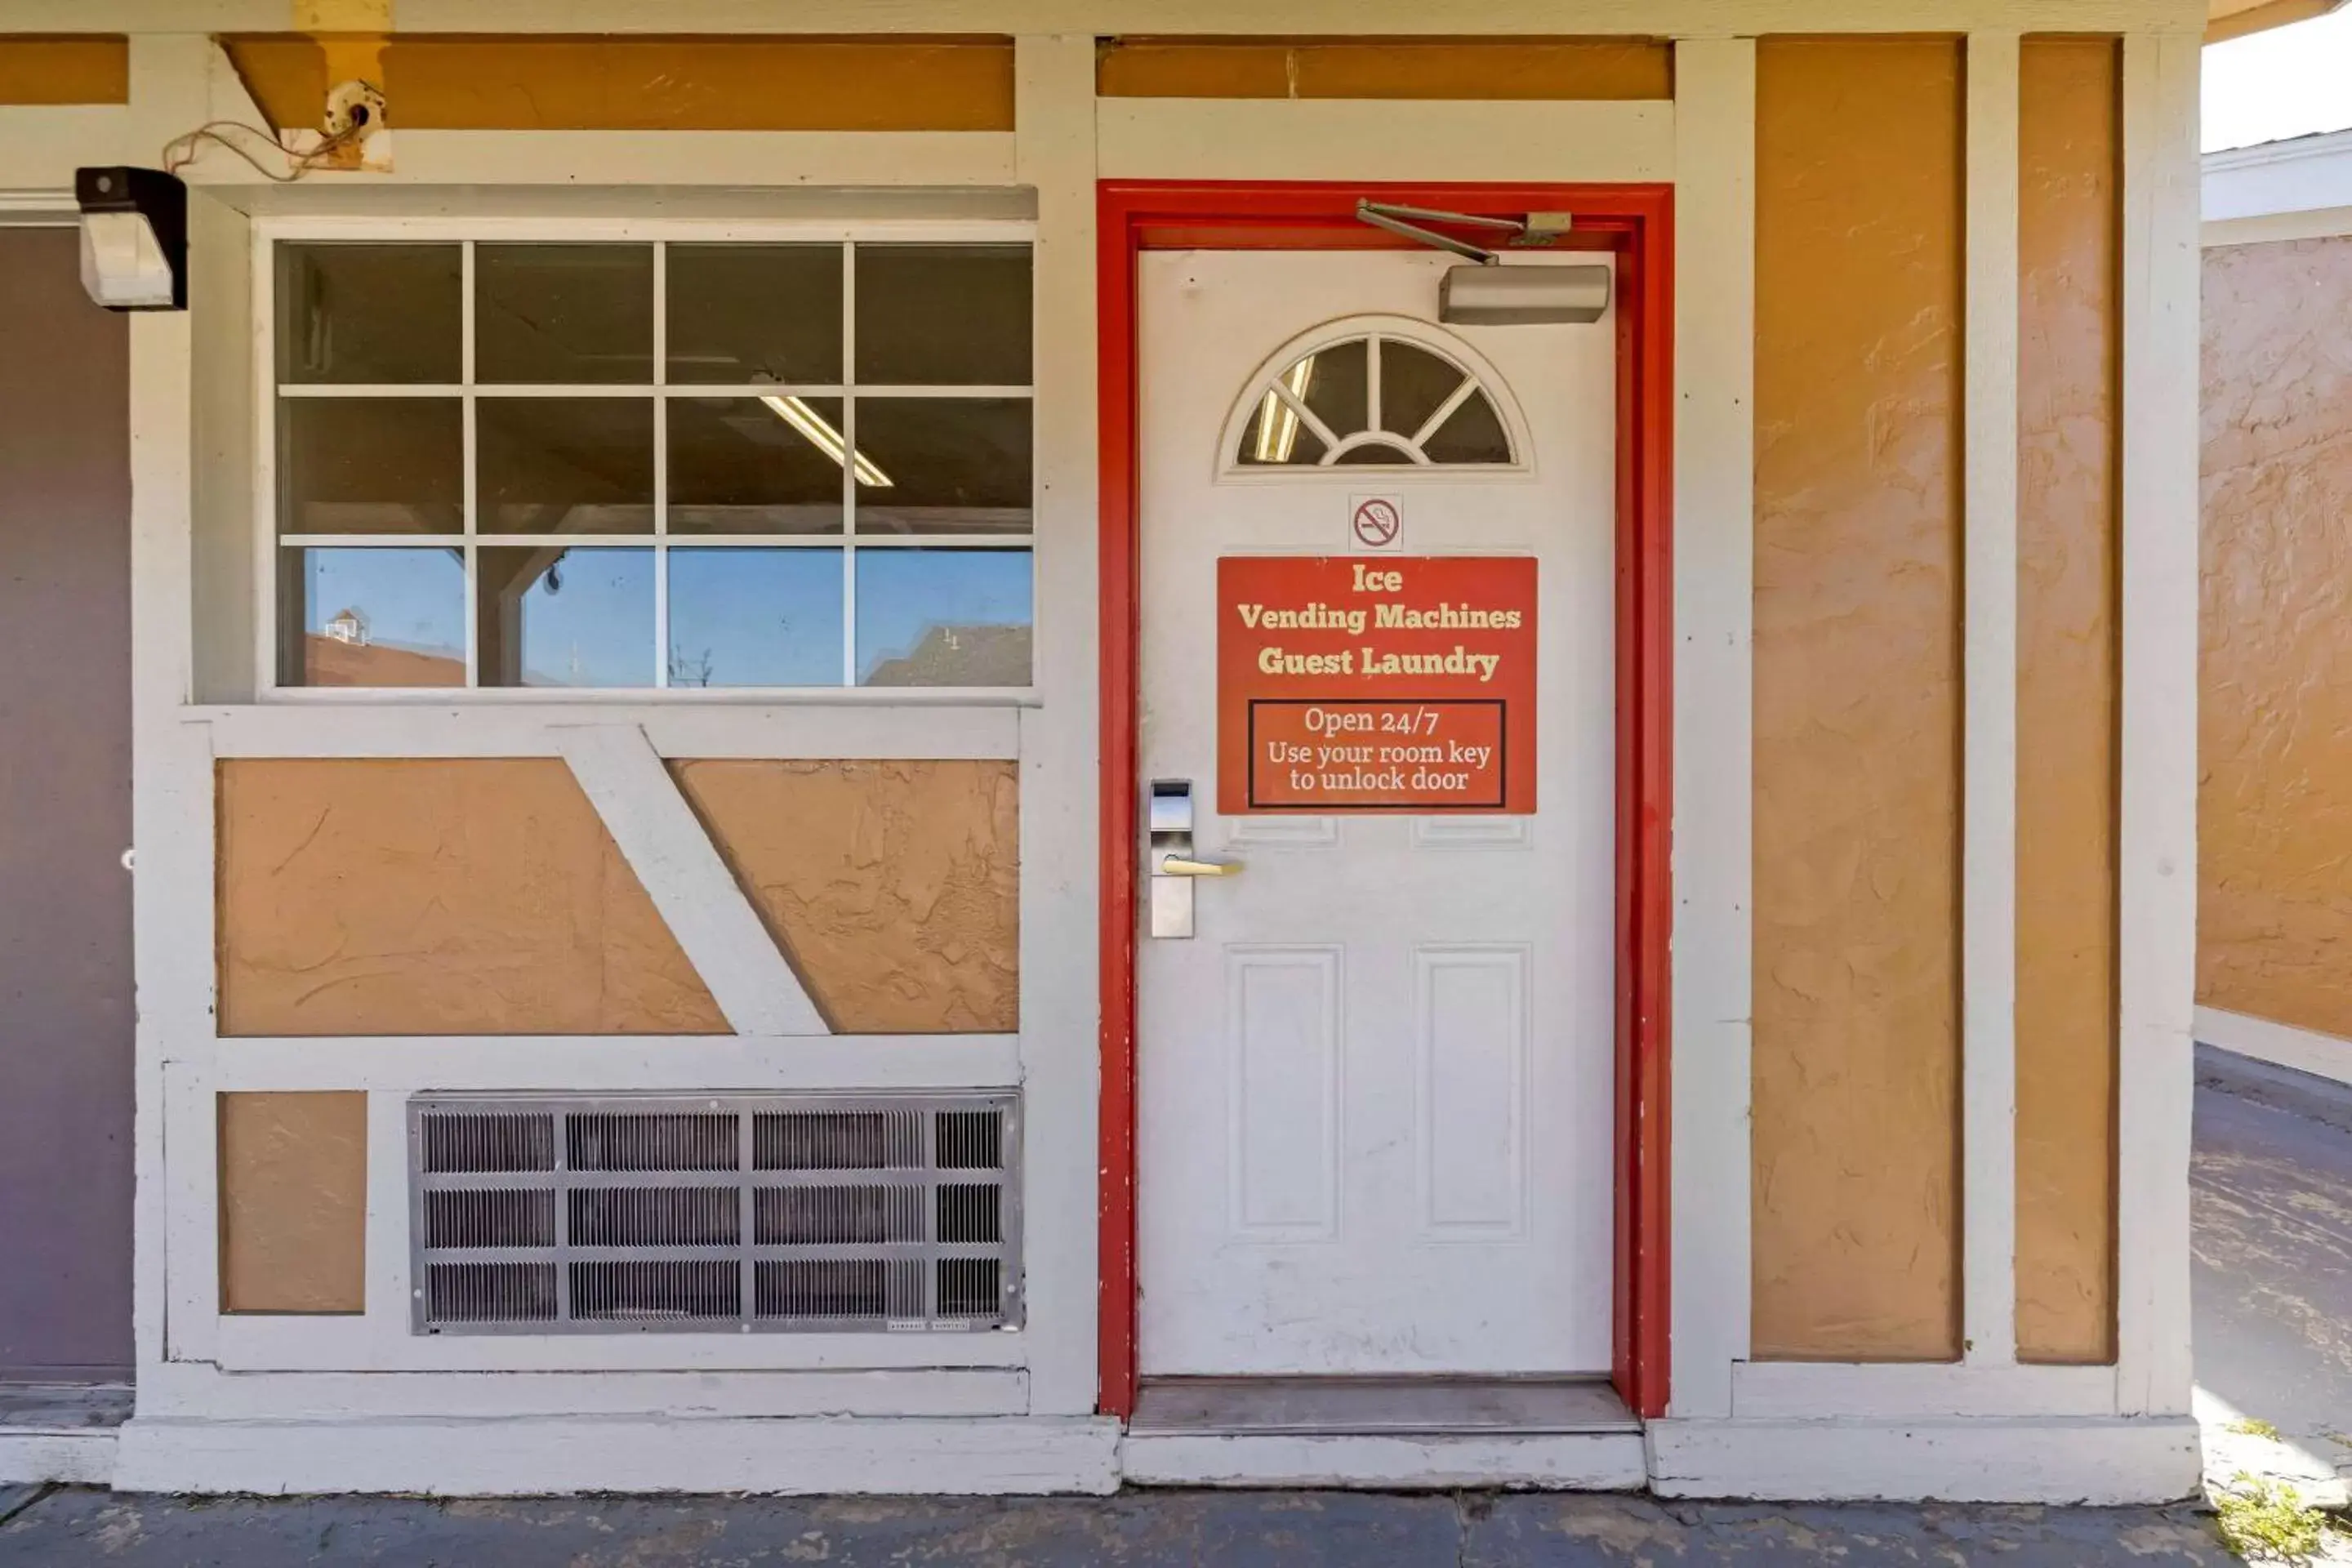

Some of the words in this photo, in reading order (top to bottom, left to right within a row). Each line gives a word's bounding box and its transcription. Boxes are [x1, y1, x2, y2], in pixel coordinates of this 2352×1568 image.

[1352, 564, 1403, 592] Ice
[1237, 603, 1367, 635] Vending
[1374, 603, 1521, 629] Machines
[1258, 647, 1353, 675] Guest
[1361, 646, 1500, 682] Laundry
[1305, 707, 1374, 738] Open
[1381, 706, 1439, 735] 24/7
[1268, 741, 1312, 763] Use
[1317, 747, 1374, 769] your
[1379, 746, 1444, 763] room
[1449, 739, 1491, 769] key
[1290, 769, 1316, 791] to
[1319, 765, 1405, 791] unlock
[1411, 765, 1469, 791] door
